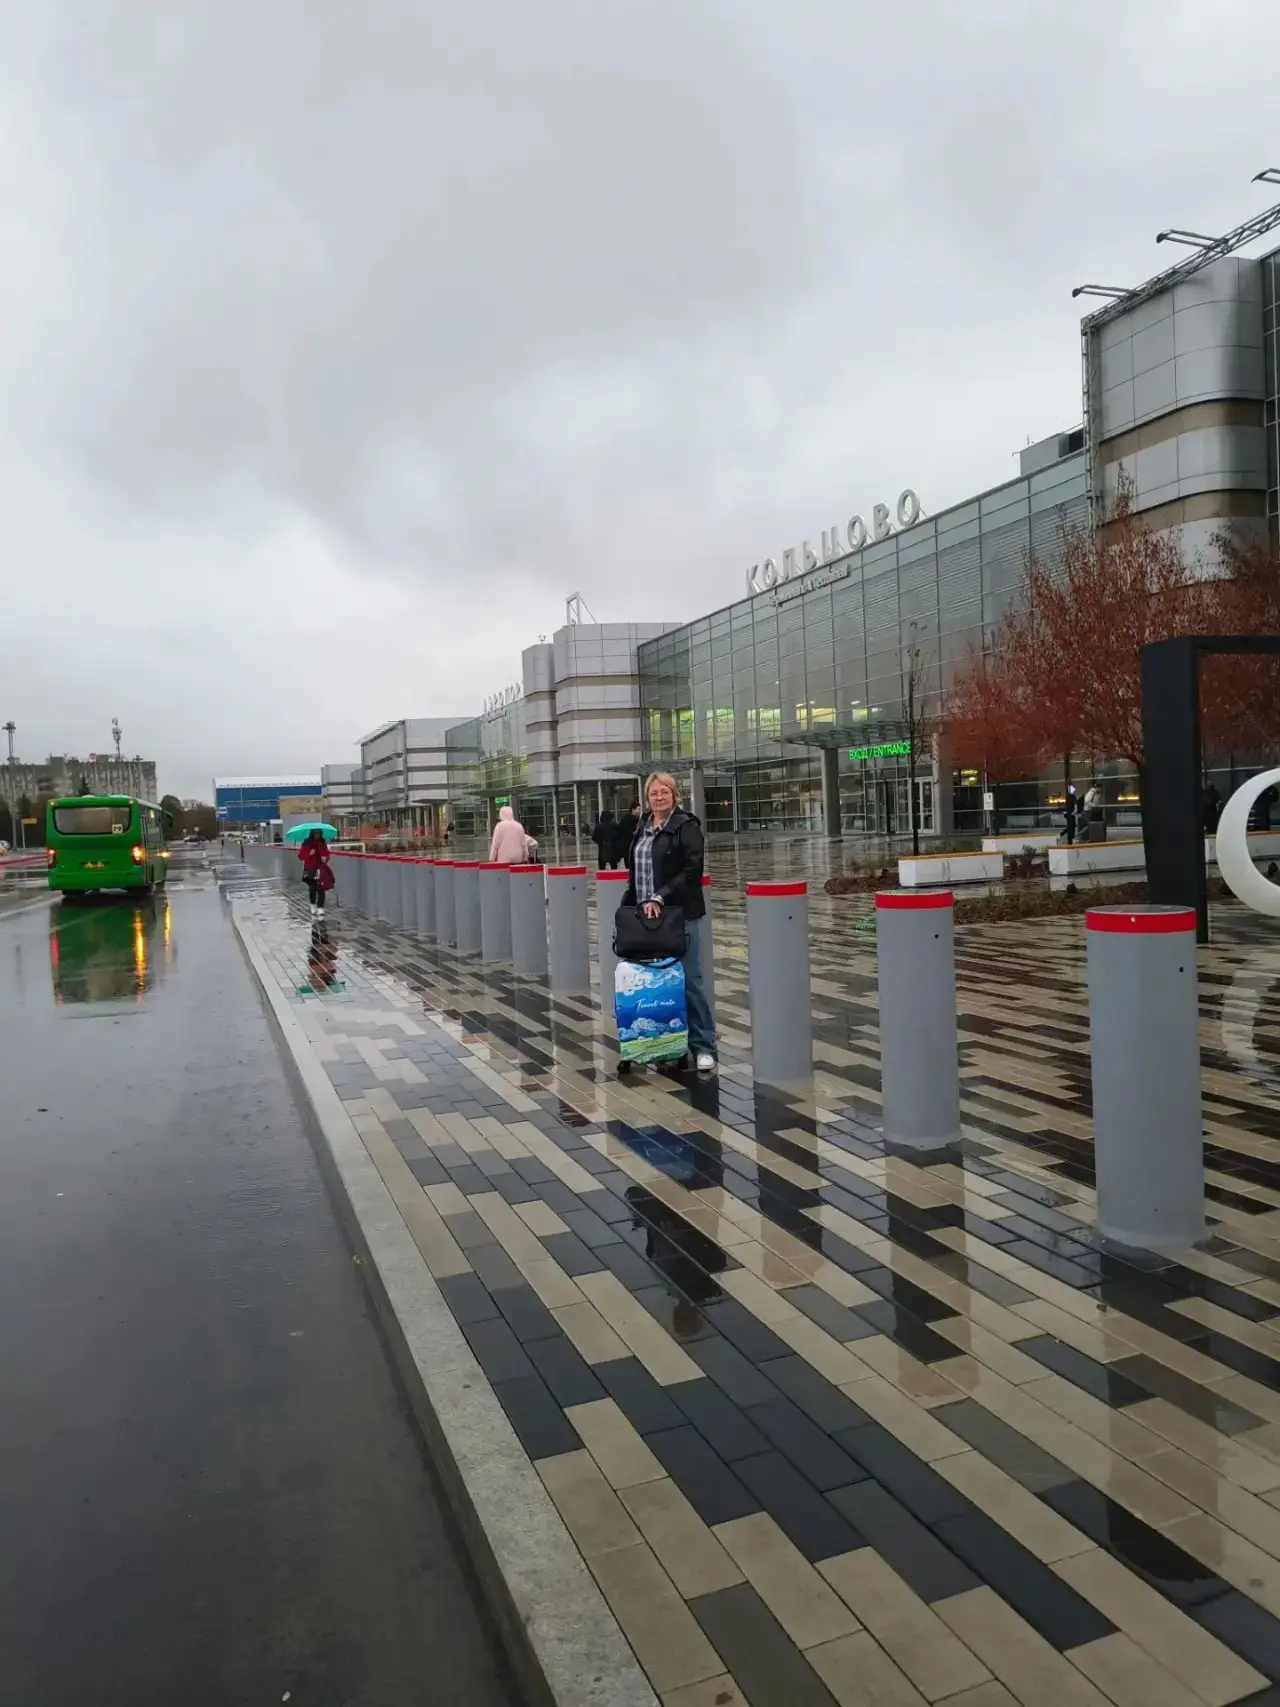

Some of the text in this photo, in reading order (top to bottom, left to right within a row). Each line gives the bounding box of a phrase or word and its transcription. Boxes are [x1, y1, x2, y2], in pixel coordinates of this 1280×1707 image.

[745, 488, 921, 598] КОЛЬЦОВО
[483, 681, 523, 713] АЭРОПОР
[849, 748, 868, 760] ВХОД
[873, 741, 911, 757] ENTRANCE
[636, 998, 658, 1012] Travel
